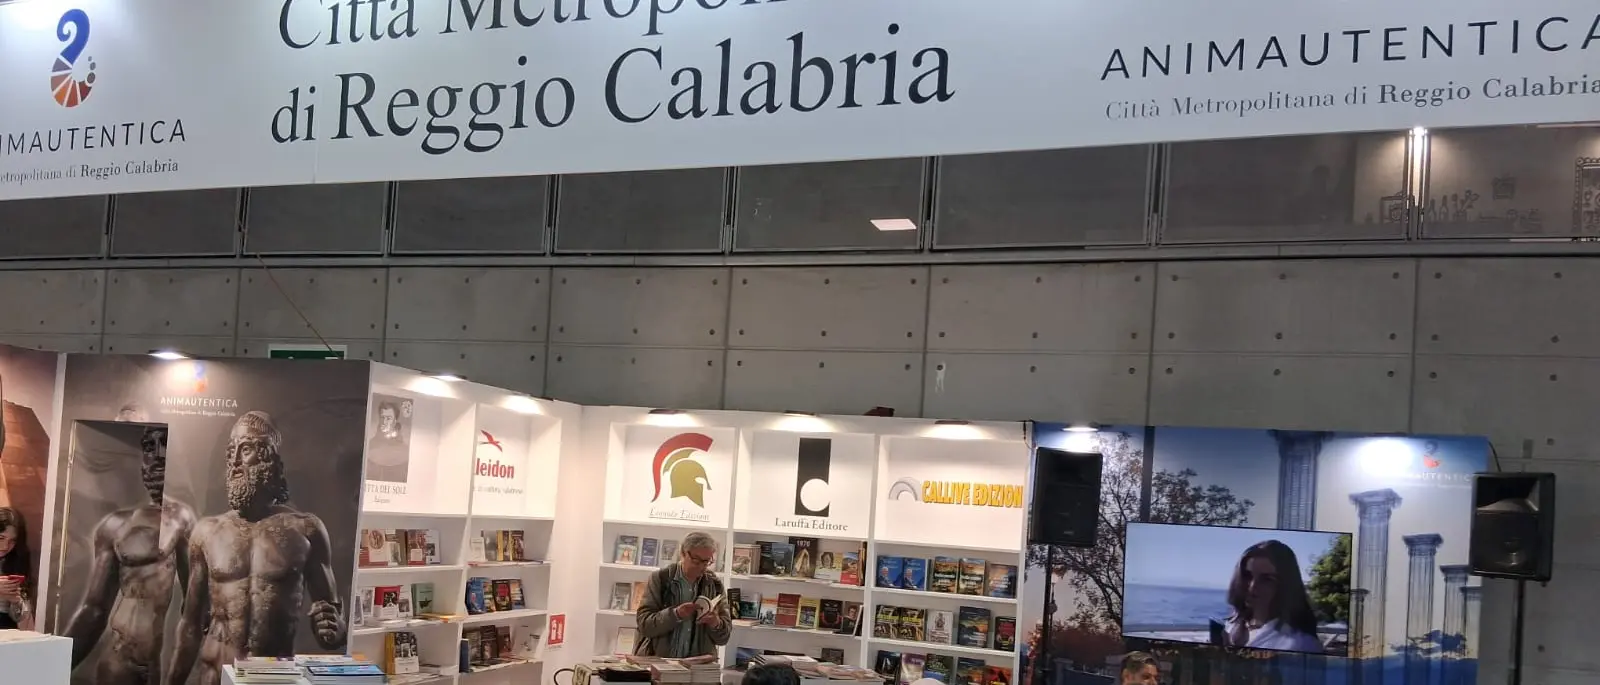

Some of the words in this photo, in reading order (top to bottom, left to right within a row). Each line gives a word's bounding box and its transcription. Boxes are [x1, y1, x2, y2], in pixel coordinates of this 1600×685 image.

[1100, 14, 1600, 80] ANIMAUTENTICA
[271, 86, 317, 143] di
[330, 55, 576, 155] Reggio
[604, 23, 956, 123] Calabria
[1105, 99, 1161, 121] Città
[1170, 91, 1335, 118] Metropolitana
[1344, 86, 1367, 105] di
[1377, 81, 1471, 107] Reggio
[65, 163, 77, 179] di
[80, 163, 121, 180] Reggio
[125, 158, 179, 175] Calabria
[160, 396, 238, 408] ANIMAUTENTICA
[473, 458, 515, 479] leidon
[922, 480, 970, 506] CALLIVE
[775, 517, 810, 529] Laruffa
[812, 519, 849, 531] Editore
